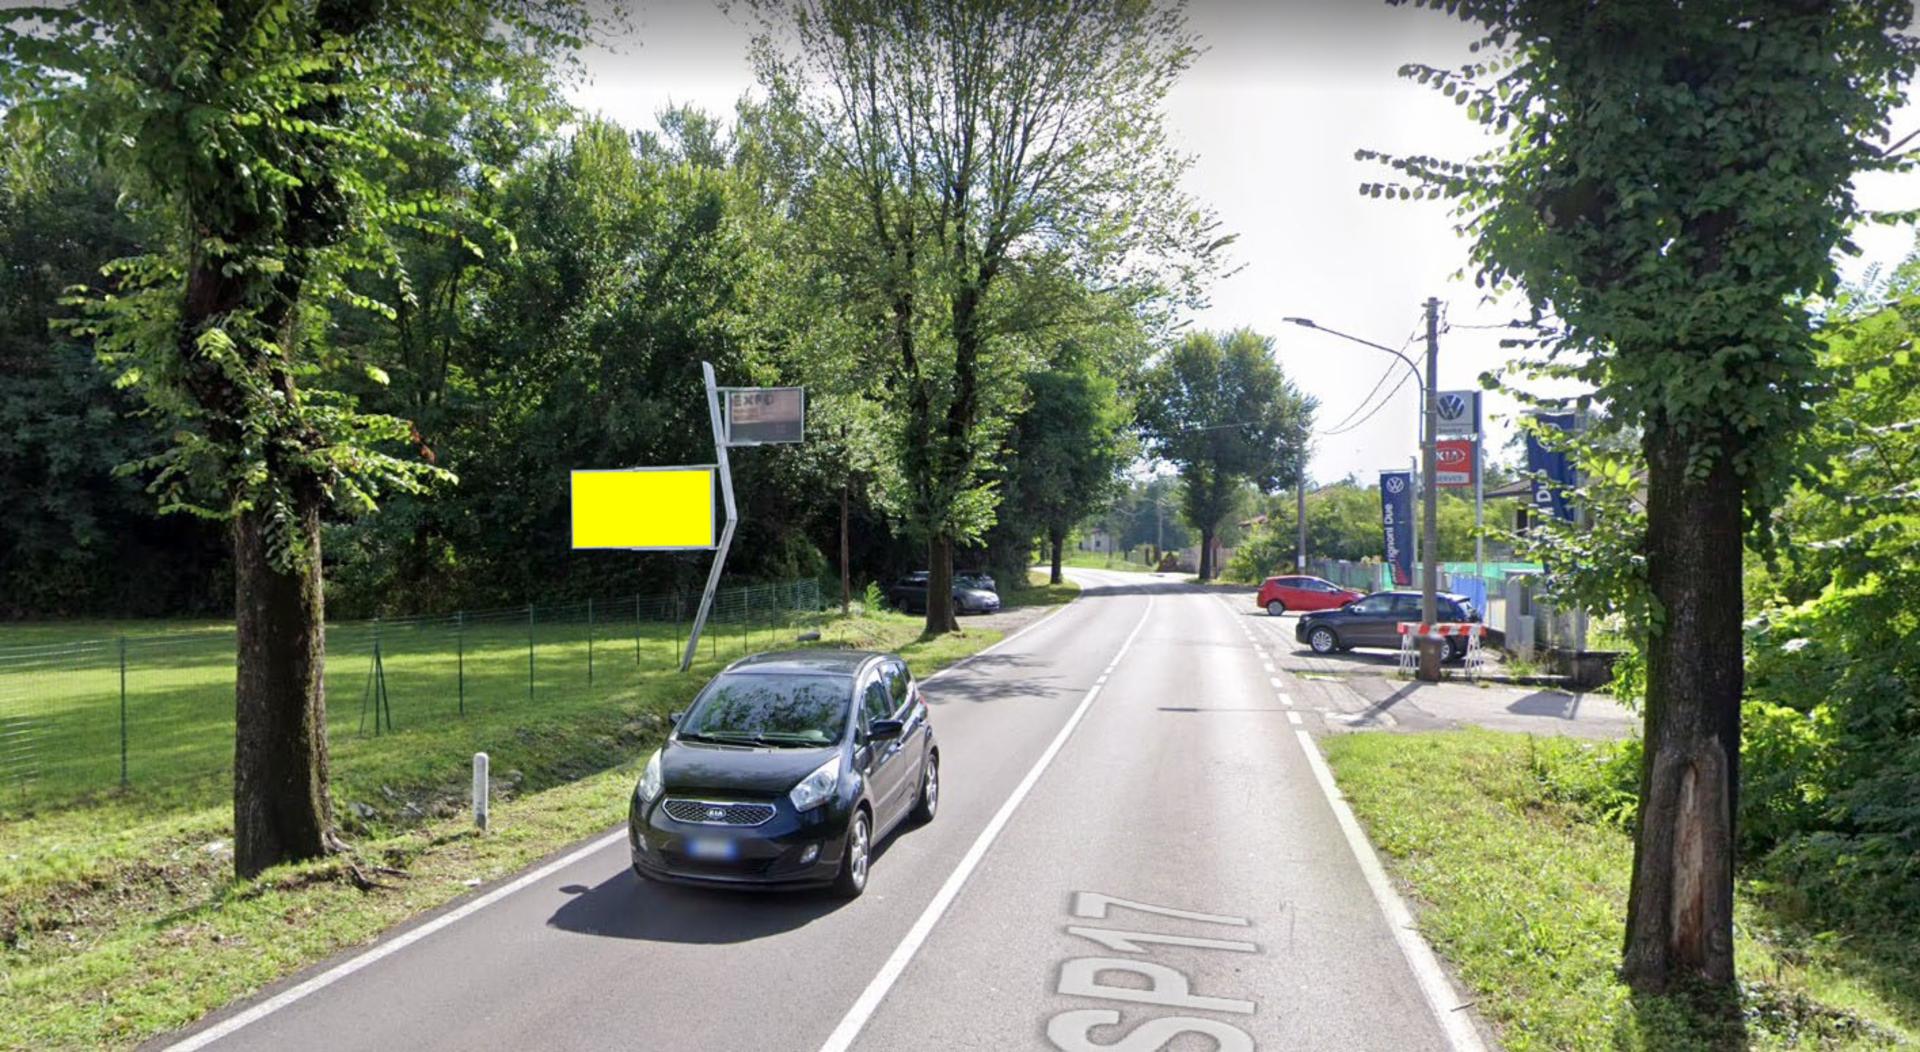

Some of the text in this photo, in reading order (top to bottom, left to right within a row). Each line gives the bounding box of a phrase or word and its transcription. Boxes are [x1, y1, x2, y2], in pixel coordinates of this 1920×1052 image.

[734, 393, 774, 407] EXPO
[1384, 503, 1394, 525] Due
[708, 808, 723, 817] KIA
